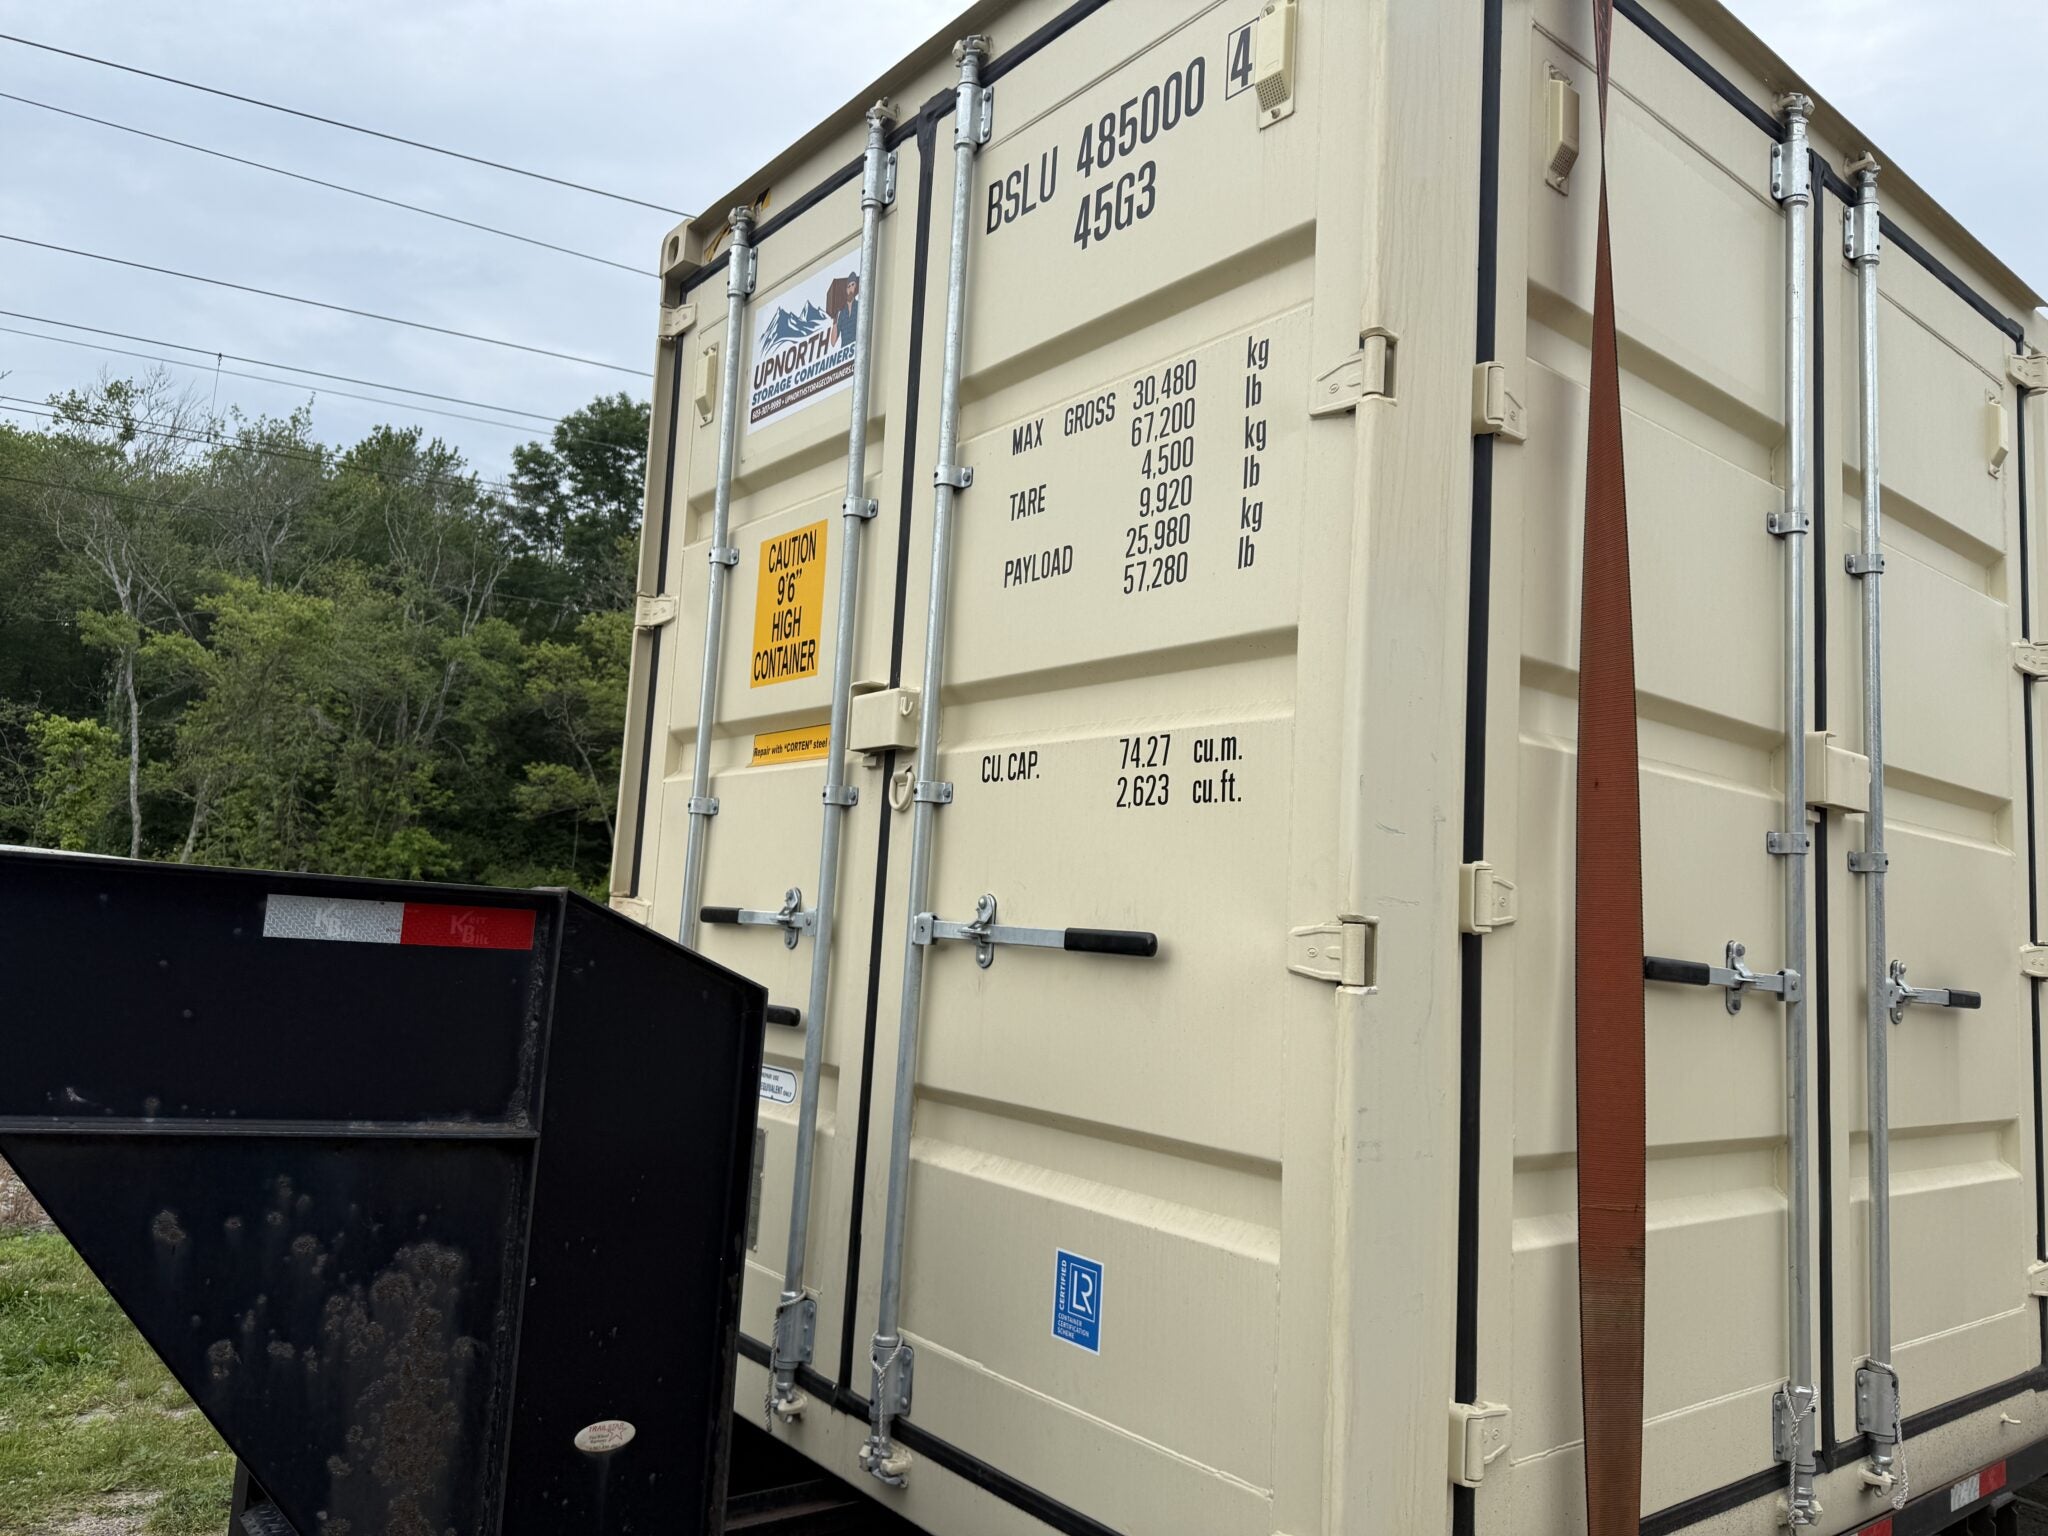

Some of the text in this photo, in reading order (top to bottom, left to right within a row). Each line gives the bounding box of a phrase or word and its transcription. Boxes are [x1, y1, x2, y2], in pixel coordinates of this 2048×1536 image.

[986, 26, 1253, 235] BSLU 485000 4
[1073, 160, 1157, 250] 45G3
[751, 344, 856, 406] STORAGE CONTAINERS
[753, 327, 831, 390] UPNORTH
[1012, 336, 1269, 456] MAX GROSS 30,480 kg
[1131, 374, 1262, 447] 67,200 lb
[1010, 416, 1267, 521] TARE 4,500 kg
[1139, 455, 1260, 517] 9,920 lb
[768, 529, 817, 573] CAUTION
[1004, 497, 1263, 588] PAYLOAD 25,980 kg
[1123, 535, 1255, 594] 57,280 lb
[771, 606, 802, 643] HIGH
[753, 639, 816, 681] CONTAINER
[753, 746, 770, 758] Repair
[772, 744, 783, 754] with
[813, 737, 828, 749] steel
[1119, 734, 1171, 770] 74.27
[1116, 773, 1170, 808] 2,623
[1058, 1259, 1067, 1311] CERTIFIED
[1072, 1270, 1093, 1314] LR
[1057, 1319, 1090, 1338] CERTIFICATION
[1057, 1326, 1075, 1339] SCHEME
[1058, 1312, 1082, 1327] CONTAINER
